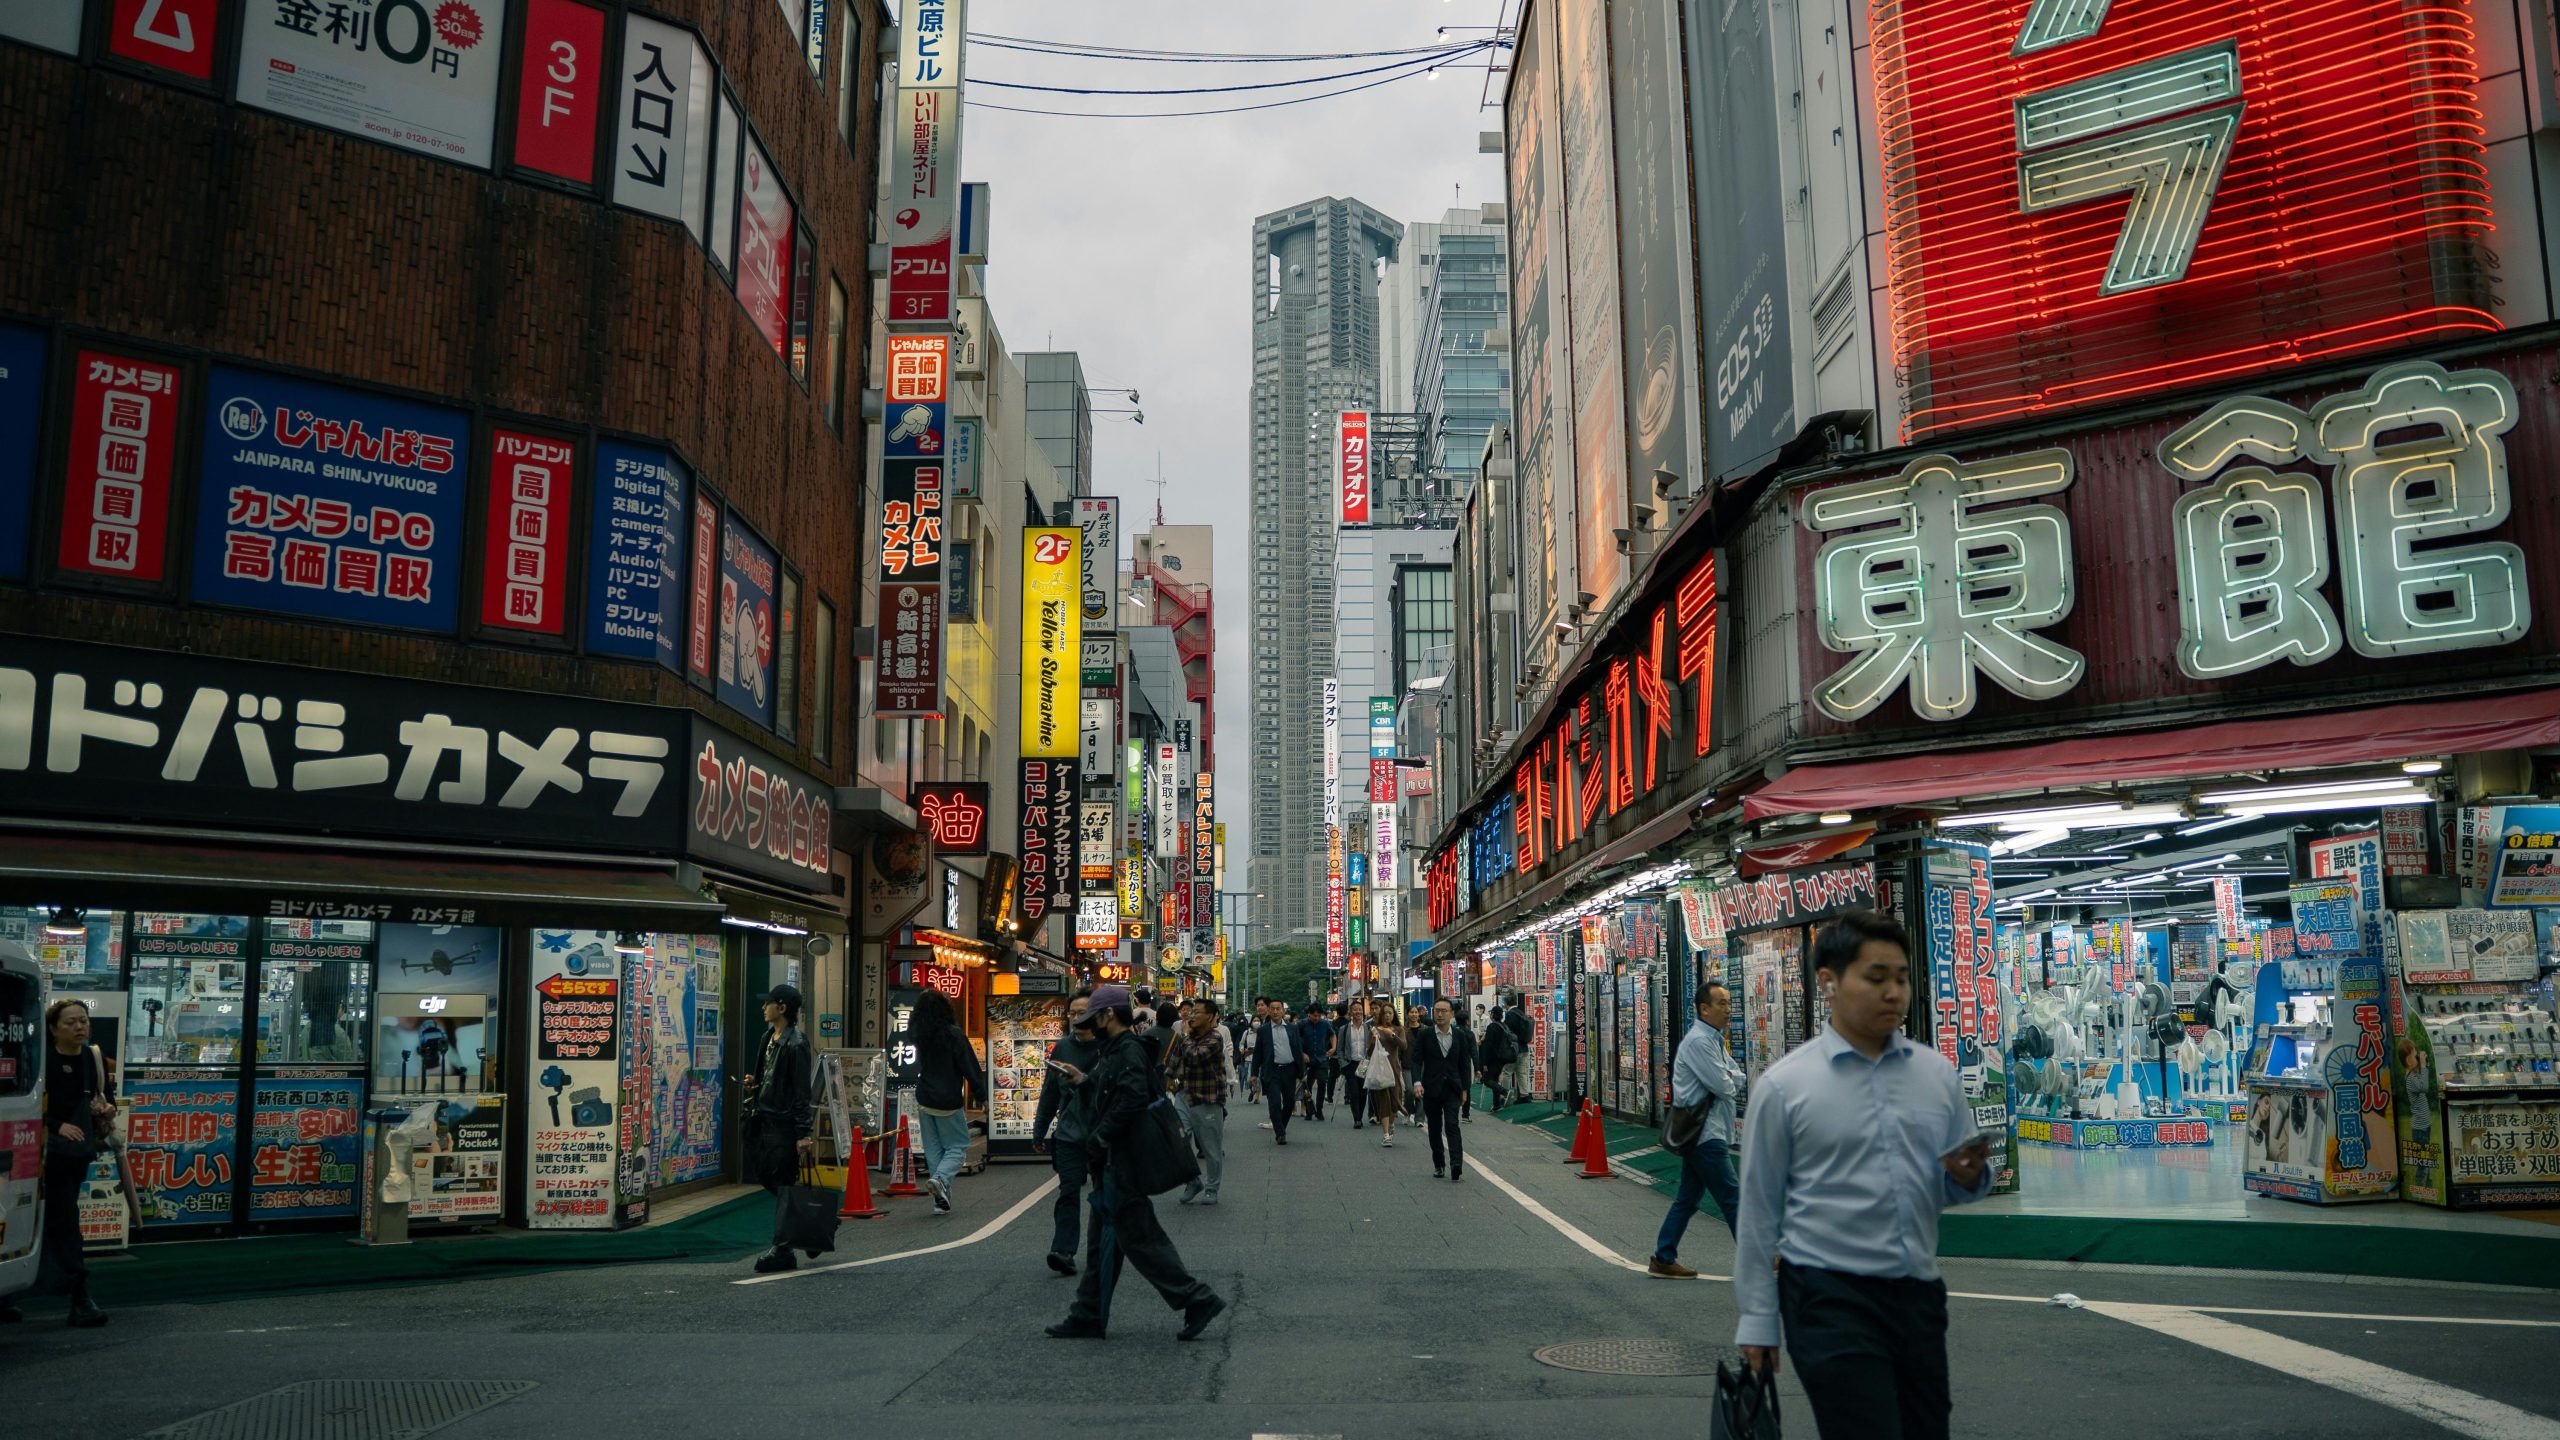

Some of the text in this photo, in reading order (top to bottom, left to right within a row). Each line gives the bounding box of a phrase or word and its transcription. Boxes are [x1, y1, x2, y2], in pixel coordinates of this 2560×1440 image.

[631, 42, 678, 141] 入口
[364, 121, 402, 138] acom.jp
[912, 91, 931, 200] いい部屋ネット
[893, 258, 947, 275] アコム
[905, 297, 933, 315] 3F
[897, 356, 938, 375] 高価
[1718, 322, 1751, 410] EOS
[897, 377, 936, 396] 買取
[1730, 378, 1764, 442] Mark IV
[919, 434, 939, 453] 2F
[95, 397, 149, 565] 高価買取
[233, 450, 438, 496] JANPARA SHINJYUKU02
[615, 458, 680, 492] デジタルカメラ
[1345, 436, 1365, 508] カラオケ
[614, 476, 660, 497] Digital
[611, 516, 663, 535] camera
[911, 466, 942, 567] ヨドバシ
[509, 469, 545, 619] 高価買取
[882, 500, 911, 575] カメラ
[1802, 361, 2532, 721] 東館
[1035, 535, 1071, 563] 2F
[224, 530, 432, 605] 高価買取
[608, 568, 661, 589] パソコン
[606, 586, 627, 600] PC
[605, 603, 663, 626] タブレット
[604, 621, 654, 641] Mobile
[1038, 599, 1060, 748] Yellow Submarine
[1325, 682, 1337, 728] カラオケ
[1515, 547, 1716, 876] ヨドバシカメラ
[1162, 764, 1173, 772] 6F
[695, 738, 831, 875] カメラ総合館
[1325, 777, 1337, 822] ダーツバー
[921, 792, 983, 845] 油
[1161, 772, 1175, 853] 買取センター
[2384, 809, 2425, 828] 年会費
[1196, 773, 1212, 874] ヨドバシカメラ
[1023, 762, 1047, 919] ヨドバシカメラ
[1052, 763, 1072, 908] ケータイアクセサリー館
[2526, 833, 2555, 849] 倍率
[2333, 846, 2356, 871] 最短
[1086, 880, 1096, 888] B1
[1128, 860, 1140, 914] おたからや
[269, 900, 476, 924] ヨドバシカメラ カメラ館
[1081, 900, 1116, 915] 生そば
[1196, 884, 1212, 926] 時計館
[1078, 917, 1116, 933] 讃岐うどん
[2297, 900, 2354, 932] 大風量
[2454, 922, 2530, 935] おすすめ単眼鏡
[139, 938, 239, 955] いらっしゃいませ
[270, 943, 362, 958] いらっしゃいませ
[1079, 937, 1107, 945] かのや
[2297, 933, 2332, 952] モバイル
[2331, 932, 2360, 950] 扇風機
[1971, 858, 1999, 1045] エアコン取付
[1930, 887, 1959, 1069] 指定日工事
[2341, 964, 2379, 980] 大風量
[550, 981, 610, 995] こちらです
[543, 1001, 614, 1015] ウェアラブルカメラ
[543, 1016, 613, 1029] 360度カメラ
[545, 1030, 610, 1044] ビデオカメラ
[556, 1044, 600, 1058] ドローン
[2355, 1003, 2389, 1112] モバイル
[133, 1092, 237, 1107] ヨドバシカメラ
[256, 1090, 350, 1106] 新宿西口本店
[255, 1111, 295, 1127] 品揃え
[1977, 1106, 2005, 1125] 年中無休
[127, 1111, 236, 1145] 圧倒的な
[255, 1129, 297, 1139] から選べて
[458, 1128, 488, 1139] Osmo
[2156, 1122, 2209, 1144] 扇風機
[2333, 1083, 2367, 1169] 扇風機
[458, 1138, 499, 1149] Pocket4
[536, 1132, 606, 1142] スタビライザーや
[2483, 1130, 2560, 1150] おすすめ
[535, 1142, 613, 1153] マイクなどの機材も
[535, 1153, 608, 1164] 当館で各種ご用意
[127, 1148, 233, 1191] 新しい
[535, 1164, 589, 1175] しております。
[2332, 1171, 2392, 1184] ヨドバシカメラ
[535, 1179, 610, 1190] ヨドバシカメラ
[546, 1189, 599, 1198] 新宿西口本店
[185, 1193, 232, 1214] も当店
[534, 1200, 609, 1217] カメラ総合館
